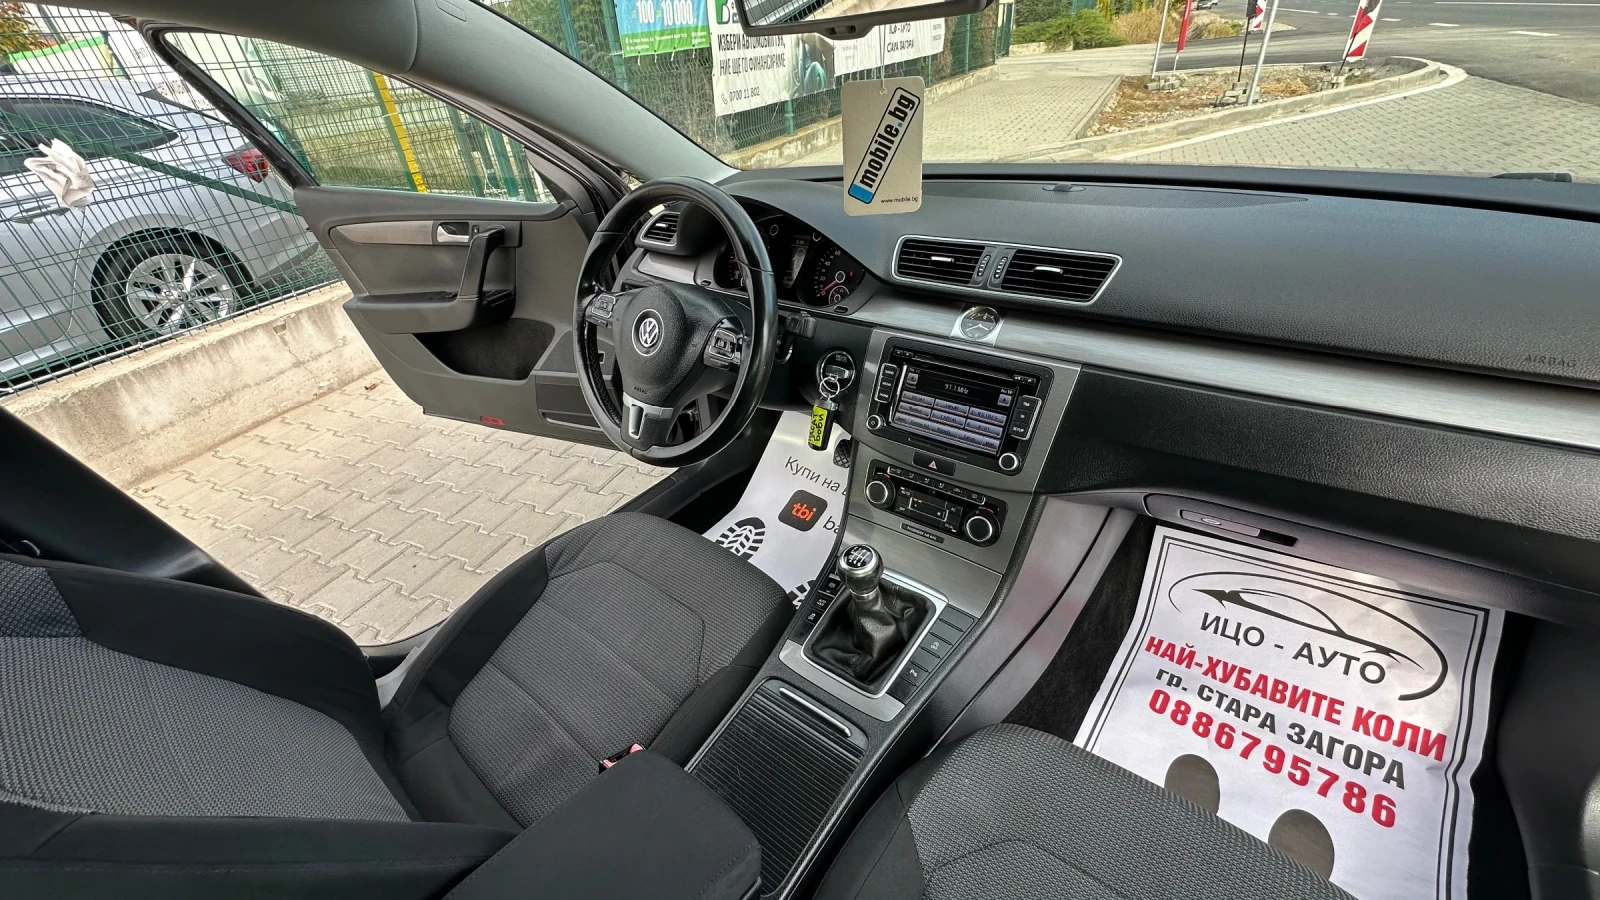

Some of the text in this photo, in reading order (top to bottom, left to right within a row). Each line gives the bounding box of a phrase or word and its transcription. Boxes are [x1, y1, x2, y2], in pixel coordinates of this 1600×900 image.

[729, 90, 742, 102] 0700
[859, 94, 916, 189] mobile.bg
[1524, 353, 1577, 368] AIRBAG
[944, 383, 969, 395] 91.1 MHz
[784, 456, 841, 492] Купи на
[791, 502, 817, 522] tbi
[1200, 612, 1265, 647] ИЦО
[1293, 641, 1387, 684] АУТО
[1144, 635, 1448, 762] НАЙ-ХУБАВИТЕ КОЛИ
[1155, 666, 1406, 790] гр. СТАРА ЗАГОРА
[1148, 688, 1397, 828] 0886795786
